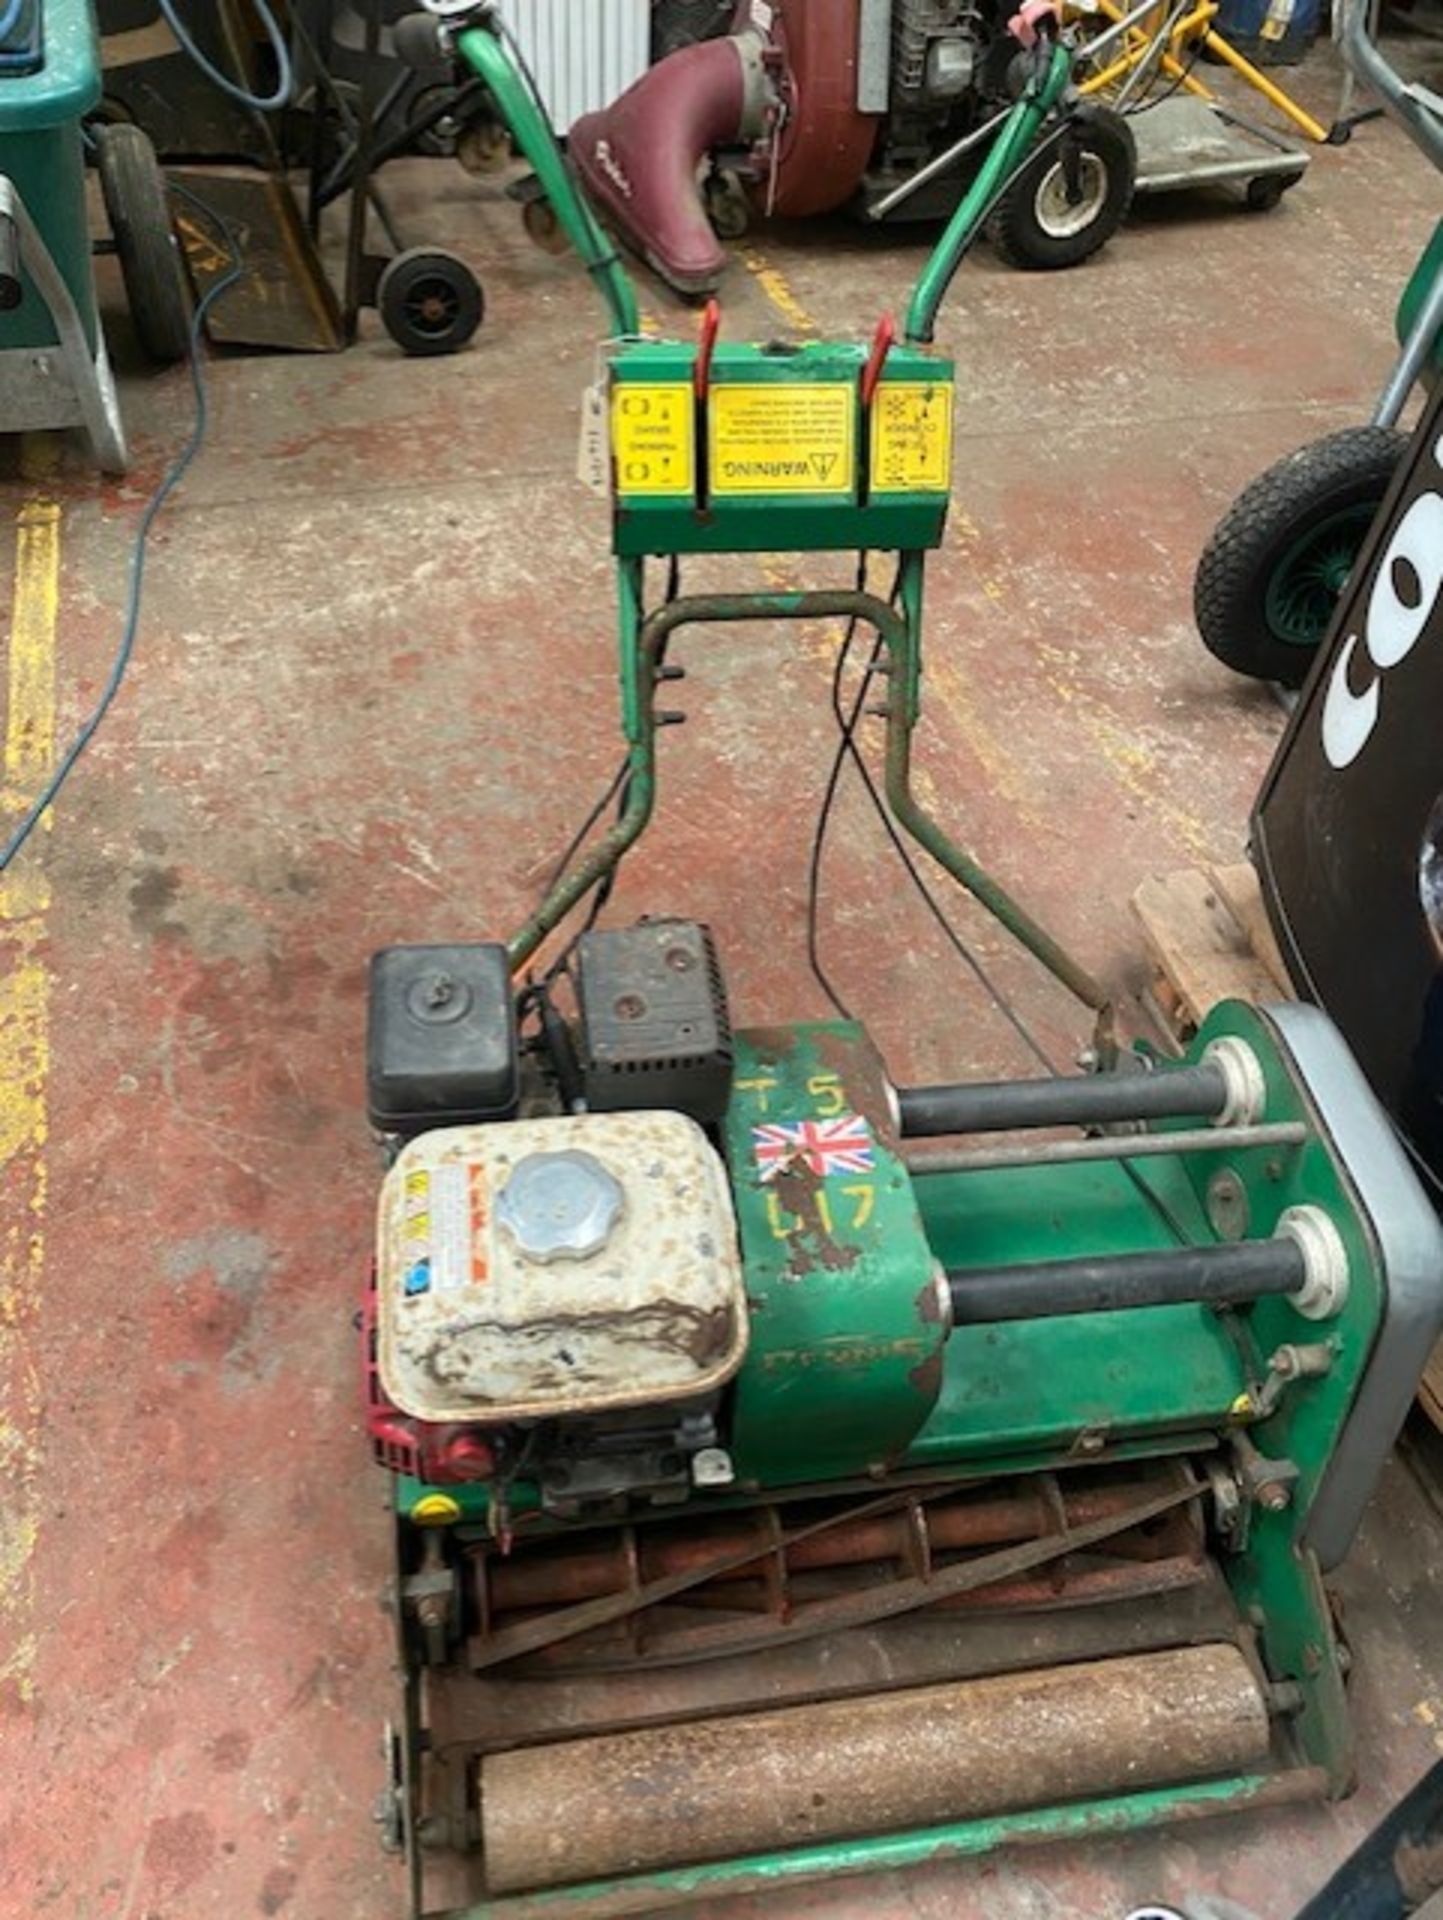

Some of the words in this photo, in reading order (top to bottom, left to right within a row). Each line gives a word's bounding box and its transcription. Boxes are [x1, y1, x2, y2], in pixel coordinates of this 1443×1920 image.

[723, 460, 811, 478] WARNING
[733, 1078, 778, 1112] T
[807, 1074, 843, 1116] 5
